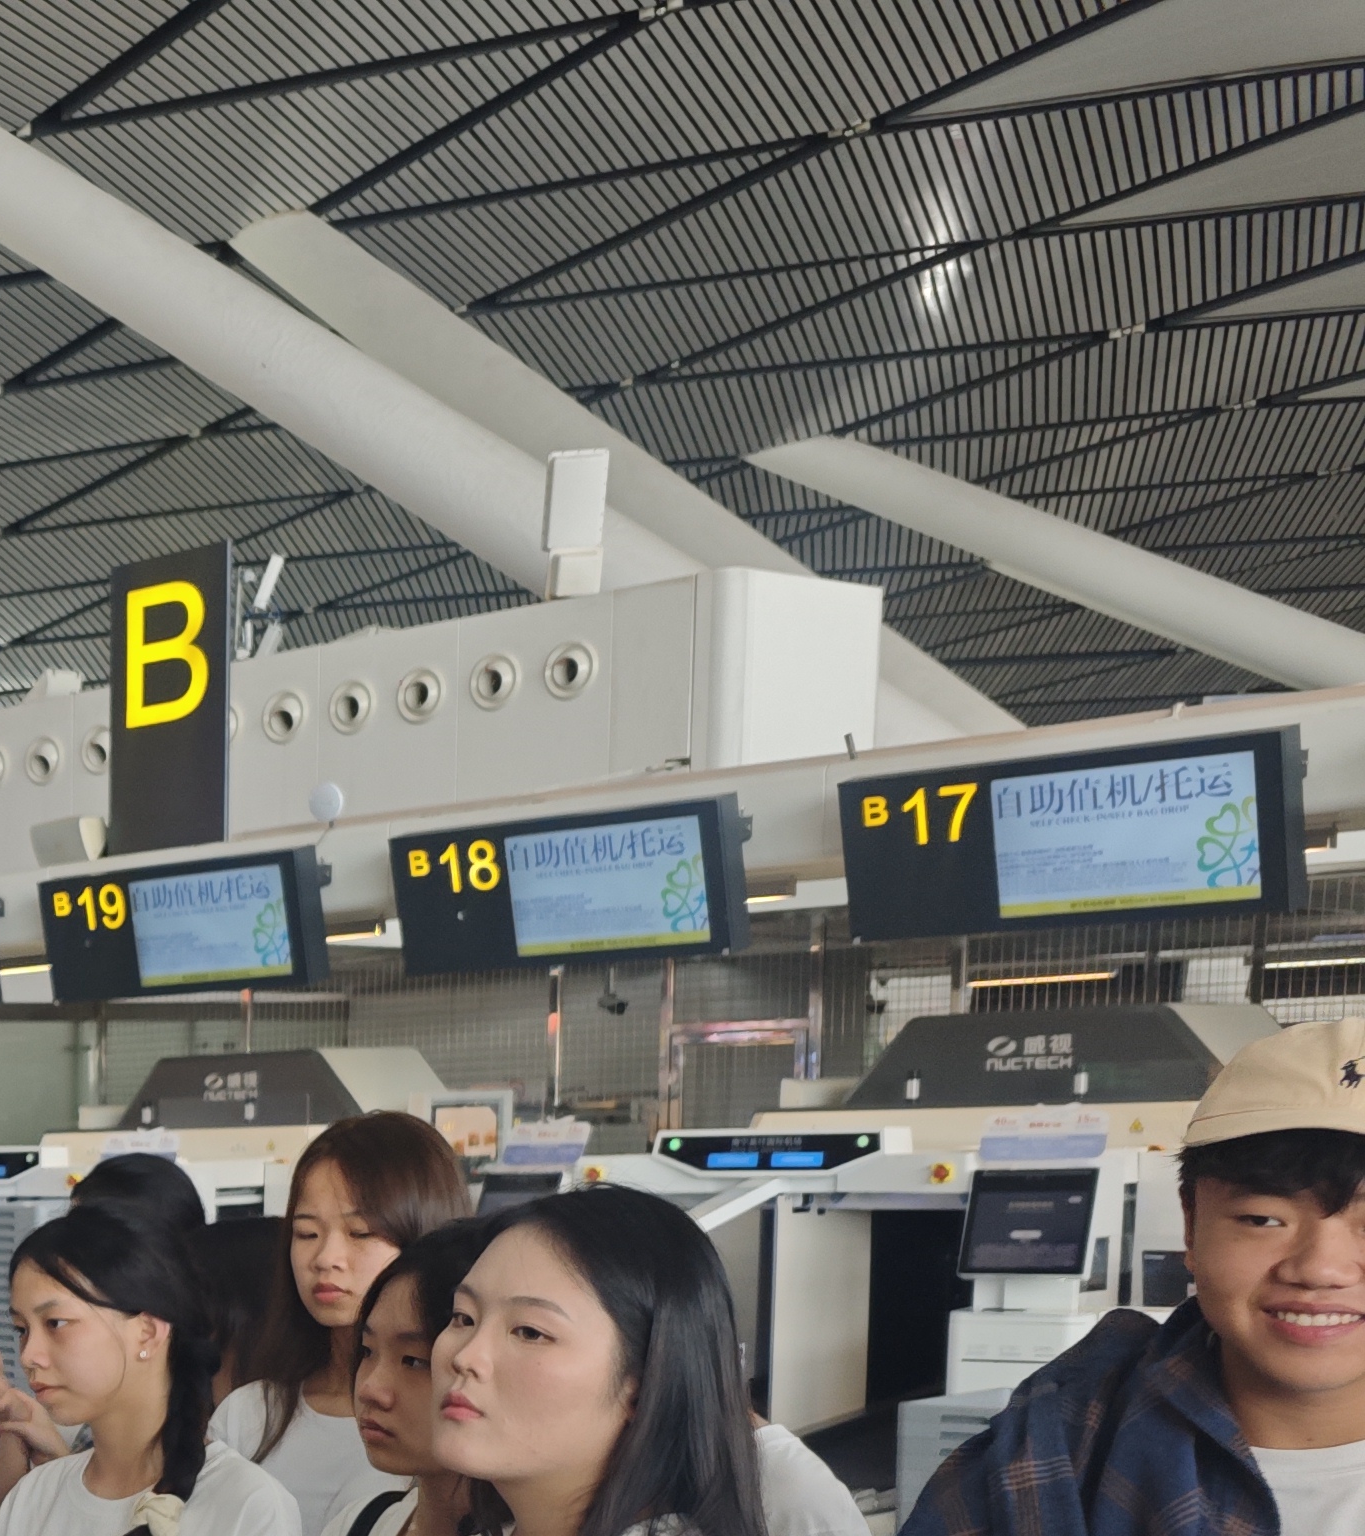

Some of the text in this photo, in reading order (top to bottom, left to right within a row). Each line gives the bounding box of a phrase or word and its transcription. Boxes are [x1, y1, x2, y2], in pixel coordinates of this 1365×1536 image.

[125, 579, 209, 730] B
[862, 782, 979, 845] B 17
[996, 762, 1234, 820] 自助值机/托运
[408, 849, 431, 877] B
[439, 839, 502, 893] 18
[53, 883, 126, 931] B 19
